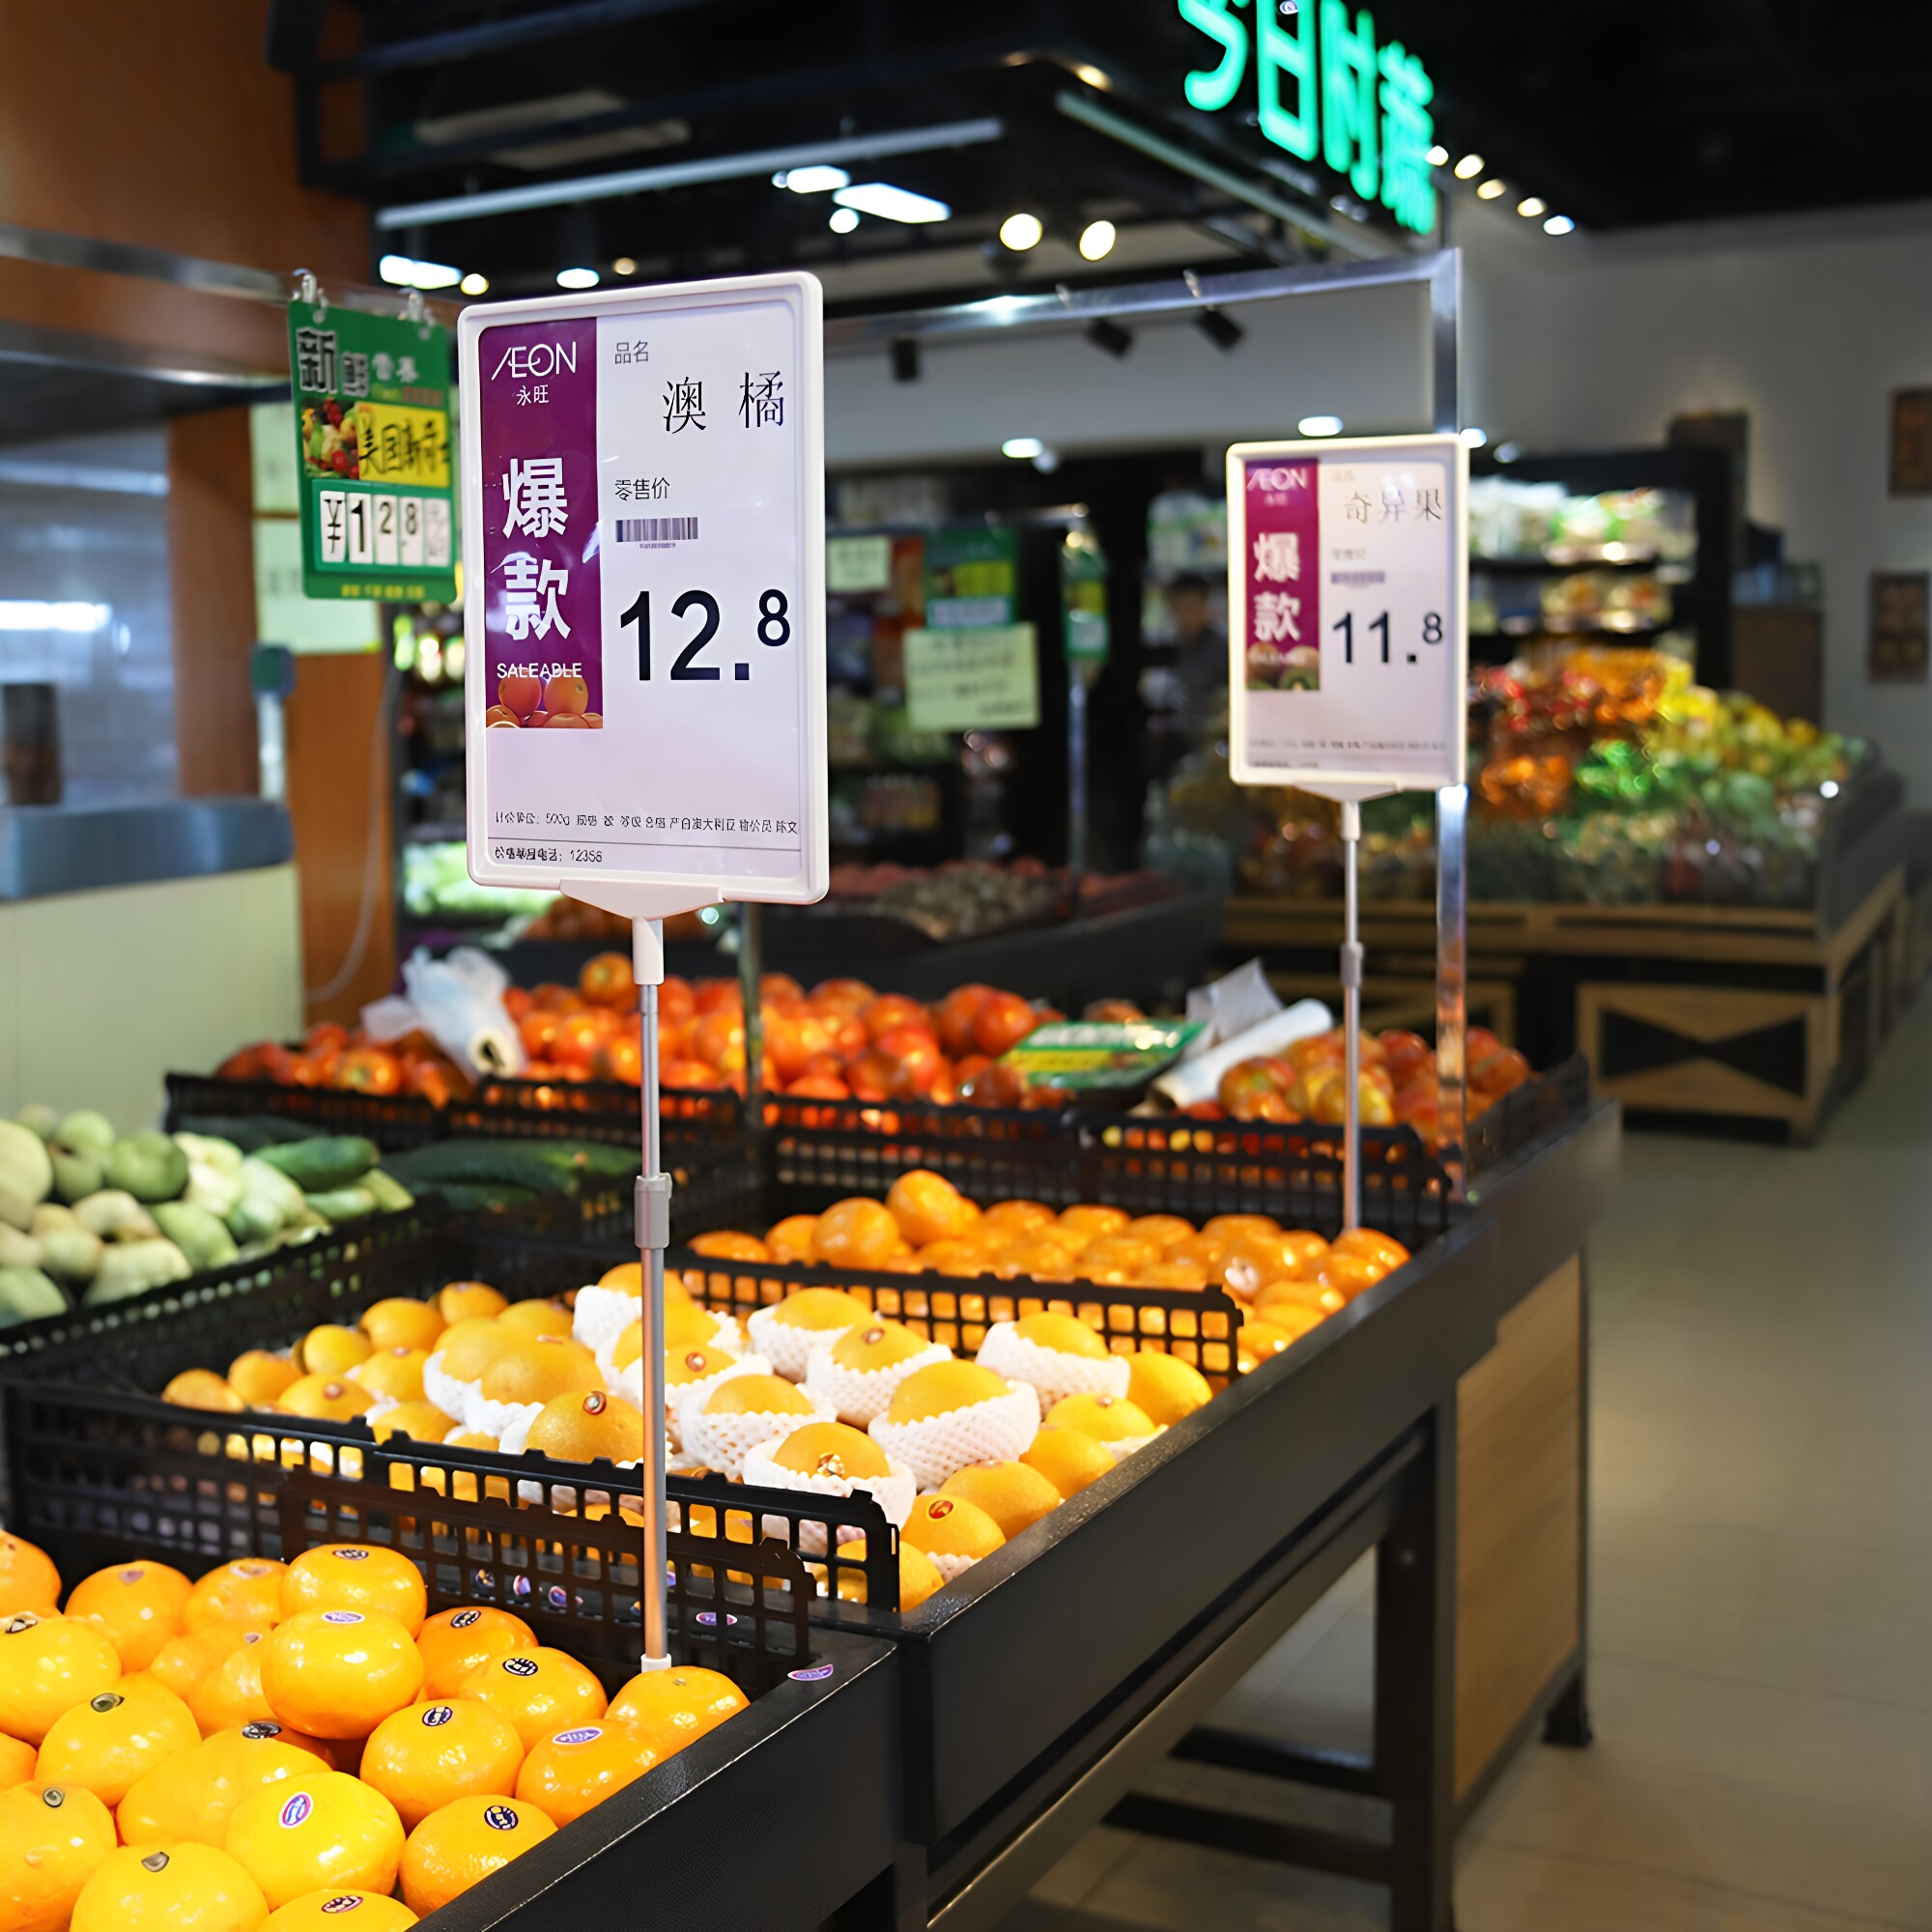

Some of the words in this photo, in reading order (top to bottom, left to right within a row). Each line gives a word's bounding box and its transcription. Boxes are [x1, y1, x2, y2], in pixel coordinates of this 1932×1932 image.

[614, 340, 650, 365] 品名
[516, 384, 550, 407] 永旺
[614, 476, 670, 501] 零售价
[501, 457, 572, 641] 爆款
[1253, 532, 1300, 641] 爆款
[620, 588, 791, 682] 12.8
[1332, 611, 1443, 664] 11.8
